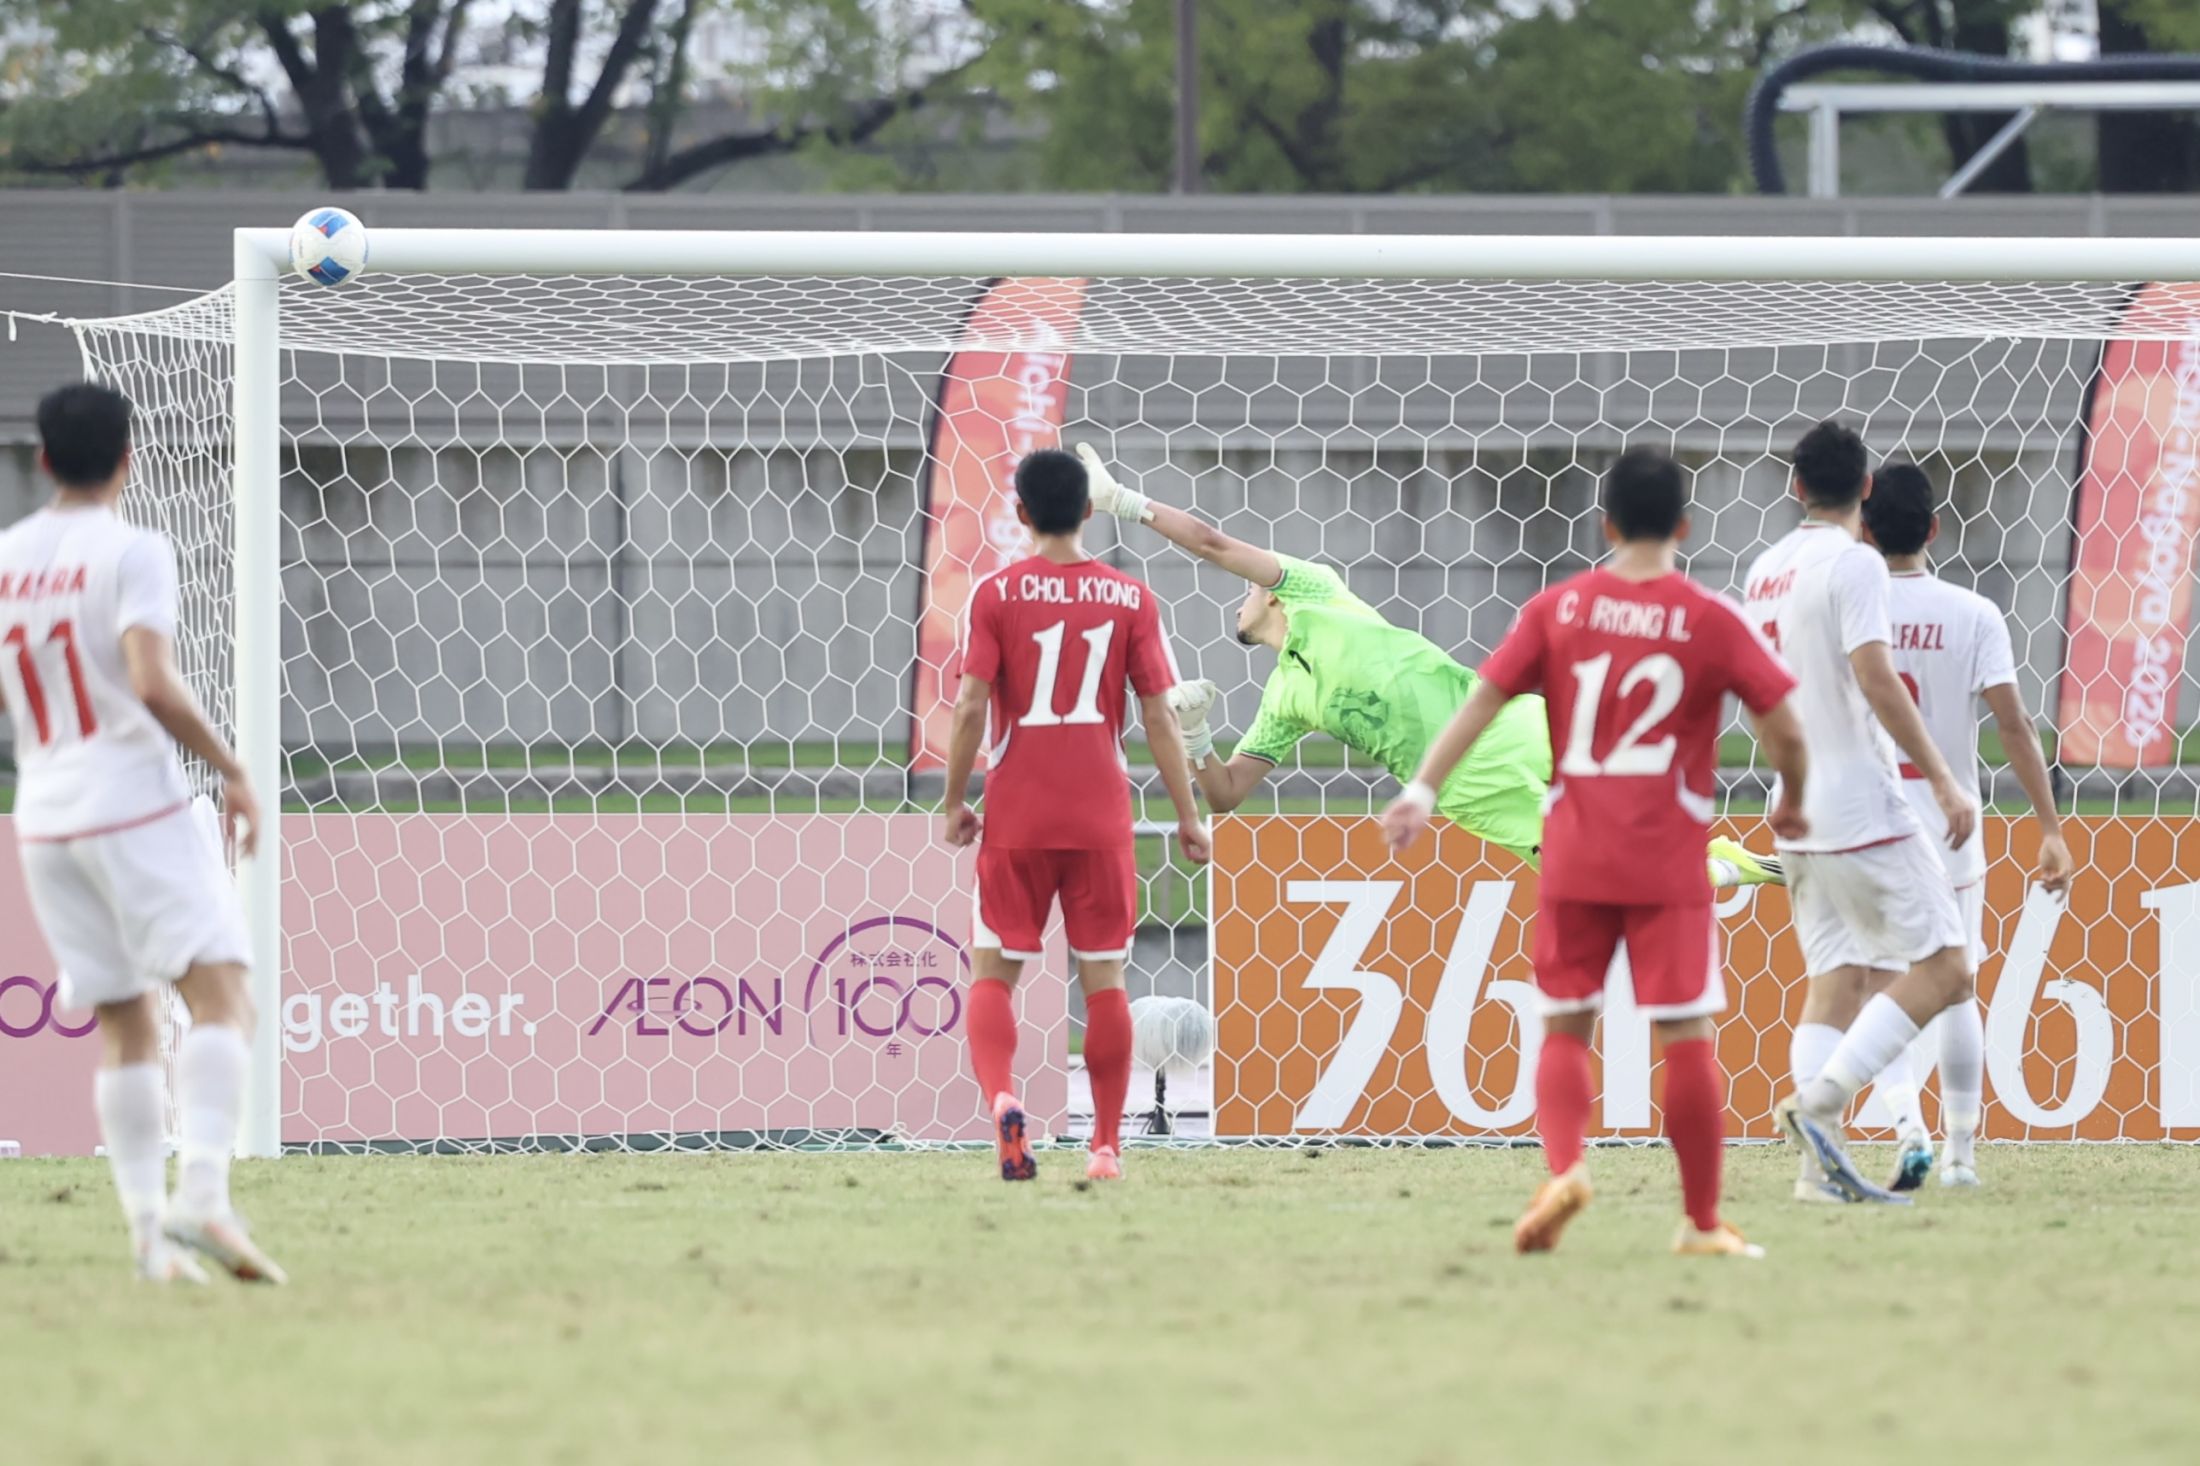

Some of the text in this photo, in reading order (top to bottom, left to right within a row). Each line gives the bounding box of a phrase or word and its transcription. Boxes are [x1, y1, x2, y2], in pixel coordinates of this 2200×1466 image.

[995, 574, 1141, 610] Y. CHOL KYONG
[1589, 594, 1666, 641] RYONG
[3, 618, 98, 747] 11
[1018, 619, 1115, 727] 11
[2124, 634, 2172, 748] 2026
[1559, 651, 1685, 777] 12
[281, 974, 538, 1053] gether.
[834, 976, 962, 1037] 100
[886, 1042, 903, 1059] 年
